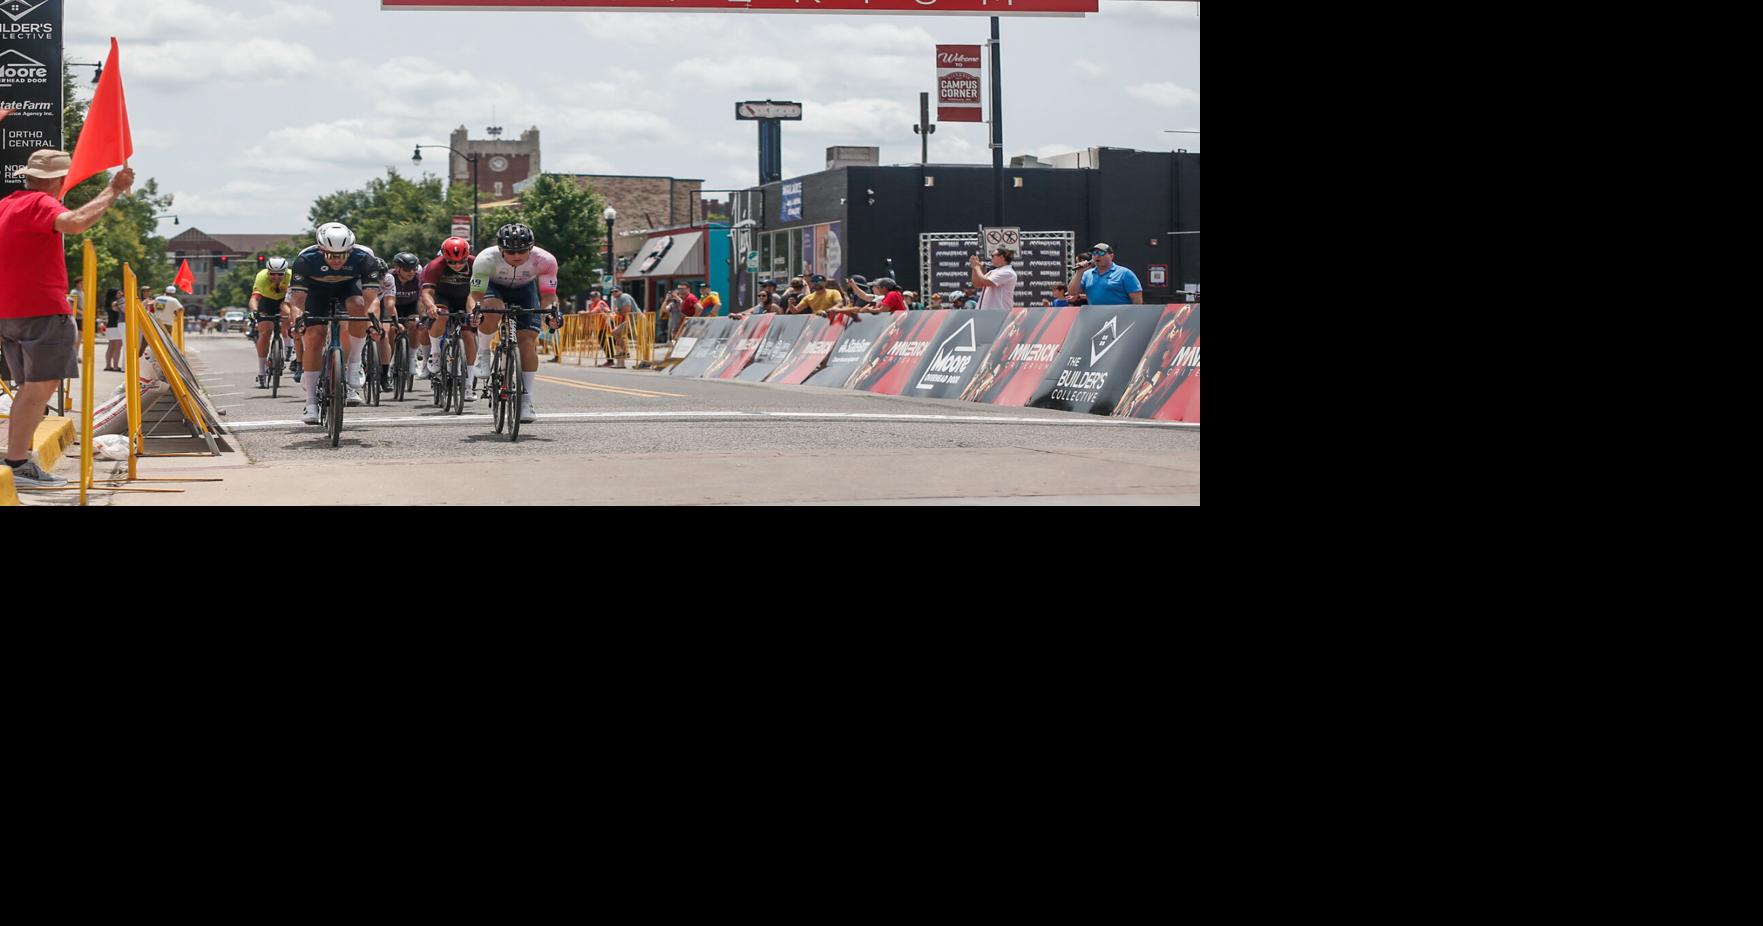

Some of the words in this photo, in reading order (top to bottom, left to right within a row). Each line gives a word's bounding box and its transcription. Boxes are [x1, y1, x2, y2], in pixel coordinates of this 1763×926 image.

[938, 52, 979, 63] Welcome
[941, 80, 978, 89] CAMPUS
[941, 89, 978, 98] CORNER
[8, 130, 43, 138] ORTHO
[8, 140, 55, 148] CENTRAL
[1007, 343, 1060, 362] MAVERICK
[930, 347, 972, 373] Moore
[1066, 356, 1082, 367] THE
[1056, 369, 1109, 390] BUILDER'S
[1051, 388, 1099, 403] COLLECTIVE
